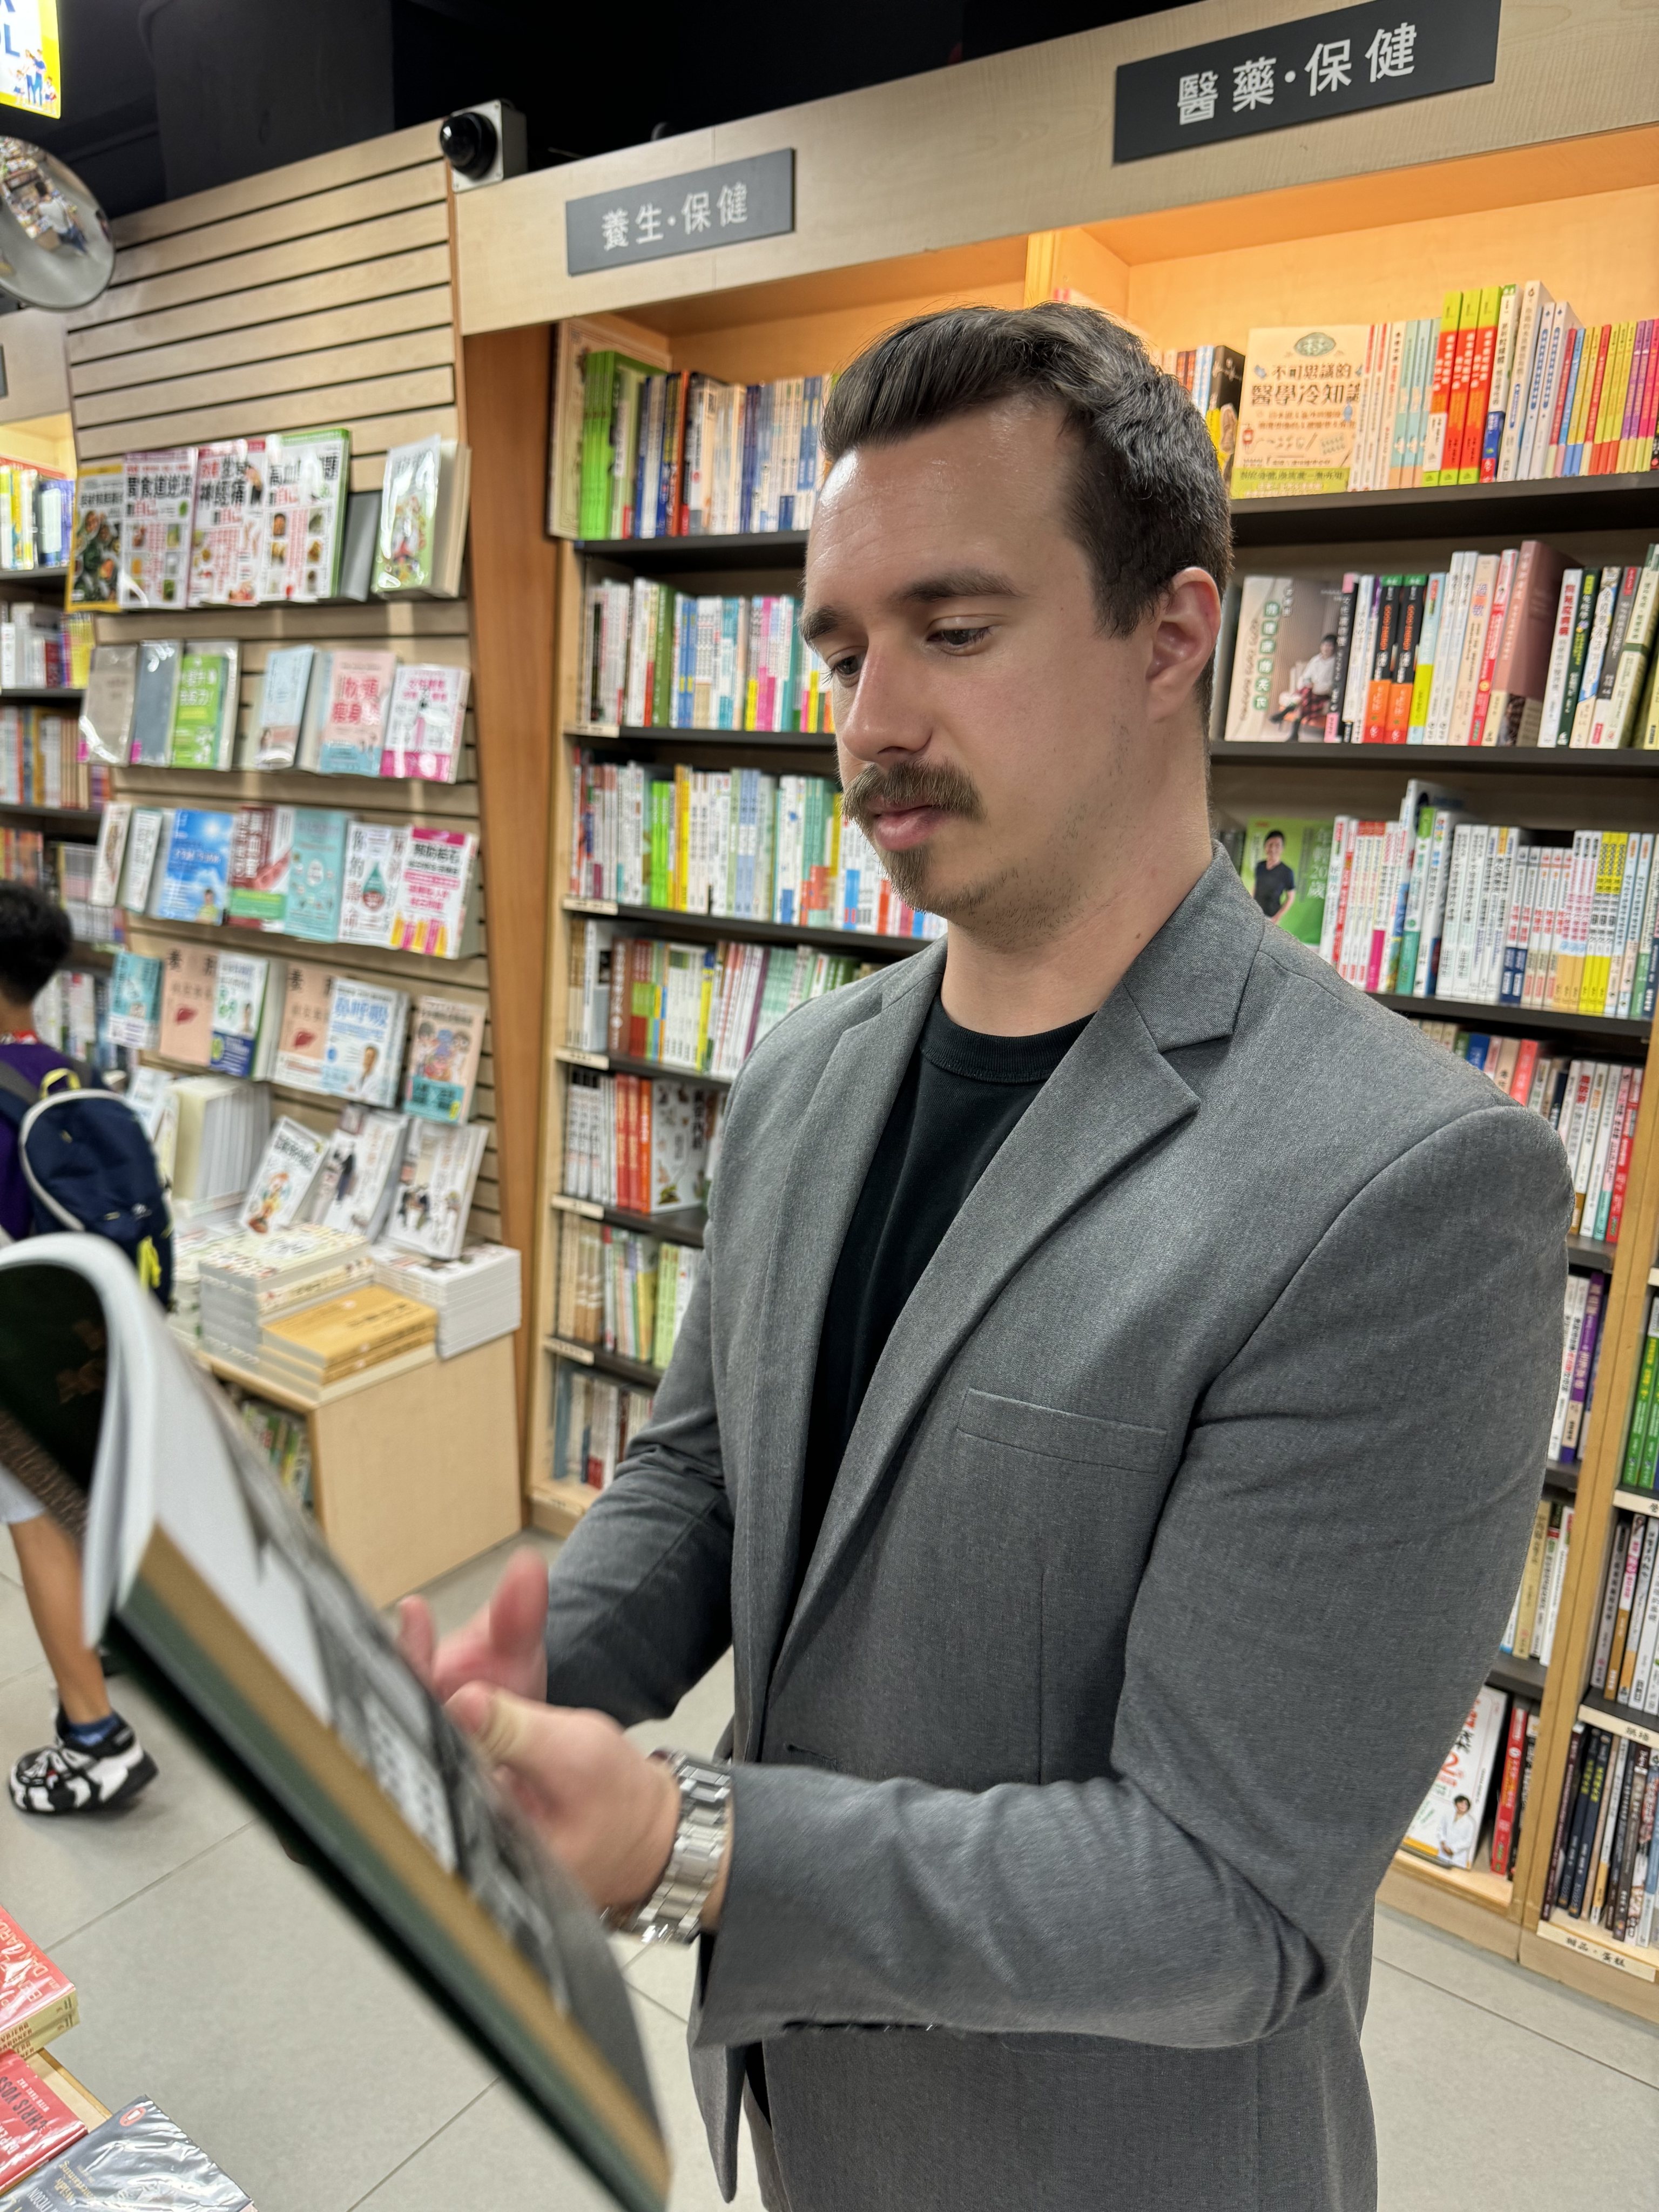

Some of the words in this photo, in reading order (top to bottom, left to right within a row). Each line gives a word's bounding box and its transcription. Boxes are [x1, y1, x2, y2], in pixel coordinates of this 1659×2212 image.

[1177, 22, 1417, 125] 醫藥·保健
[602, 181, 748, 251] 養生·保健
[1272, 362, 1351, 380] 不可思議的
[12, 2099, 48, 2132] CHRIS
